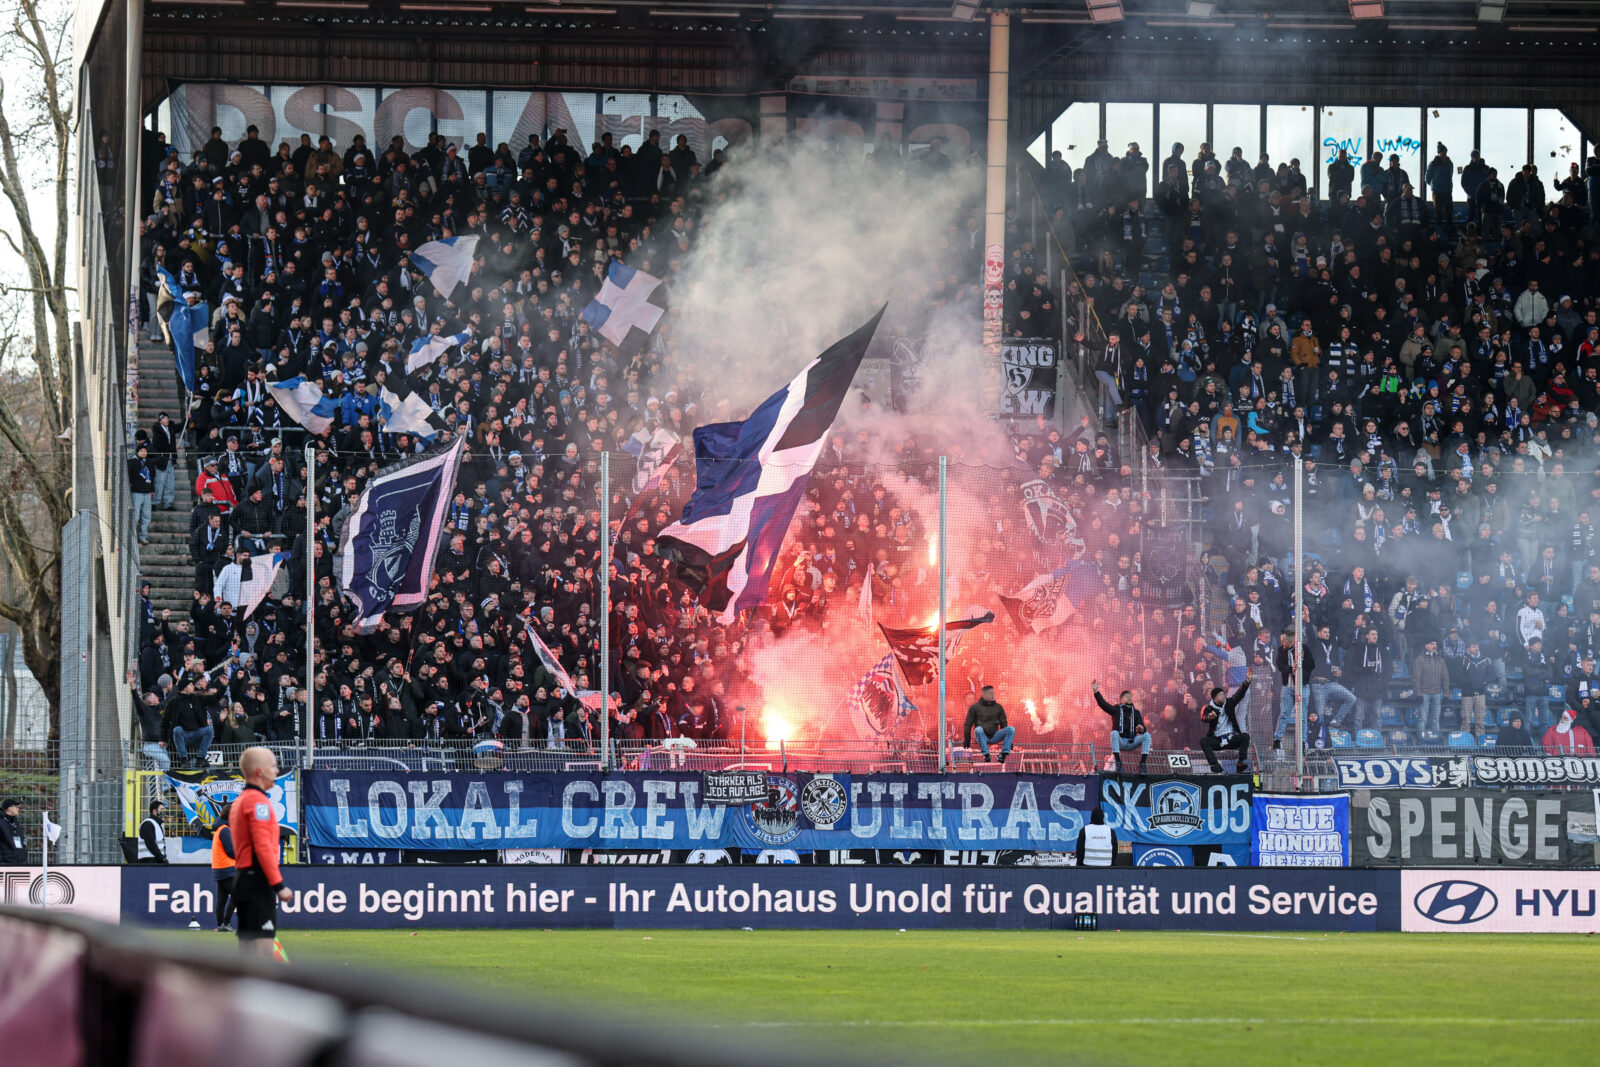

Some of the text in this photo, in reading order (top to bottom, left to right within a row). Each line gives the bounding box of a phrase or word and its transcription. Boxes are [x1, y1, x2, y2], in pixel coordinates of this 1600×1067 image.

[184, 84, 464, 158] DSC
[1170, 756, 1188, 766] 26
[1338, 760, 1431, 785] BOYS
[1474, 757, 1600, 783] SAMSON
[706, 785, 766, 796] JEDE AUFLAGE
[746, 774, 763, 785] ALS
[807, 780, 841, 792] SEKTION
[330, 779, 1086, 841] LOKAL CREW ULTRAS
[802, 799, 846, 824] STADIONVERBOT
[1102, 778, 1250, 835] SK 05
[1268, 806, 1334, 831] BLUE
[755, 830, 796, 843] BIELEFELD
[1366, 797, 1561, 860] SPENGE
[1259, 832, 1342, 852] HONOUR
[1260, 854, 1342, 866] BIELEFELD
[149, 883, 347, 912] Fahude
[360, 883, 494, 920] beginnt
[507, 883, 574, 912] hier
[609, 883, 655, 911] Ihr
[666, 883, 837, 912] Autohaus
[850, 883, 951, 912] Unold
[963, 884, 1012, 913] für
[1024, 884, 1159, 915] Qualität
[1172, 885, 1235, 914] und
[1248, 885, 1377, 915] Service
[1516, 889, 1595, 917] HYU
